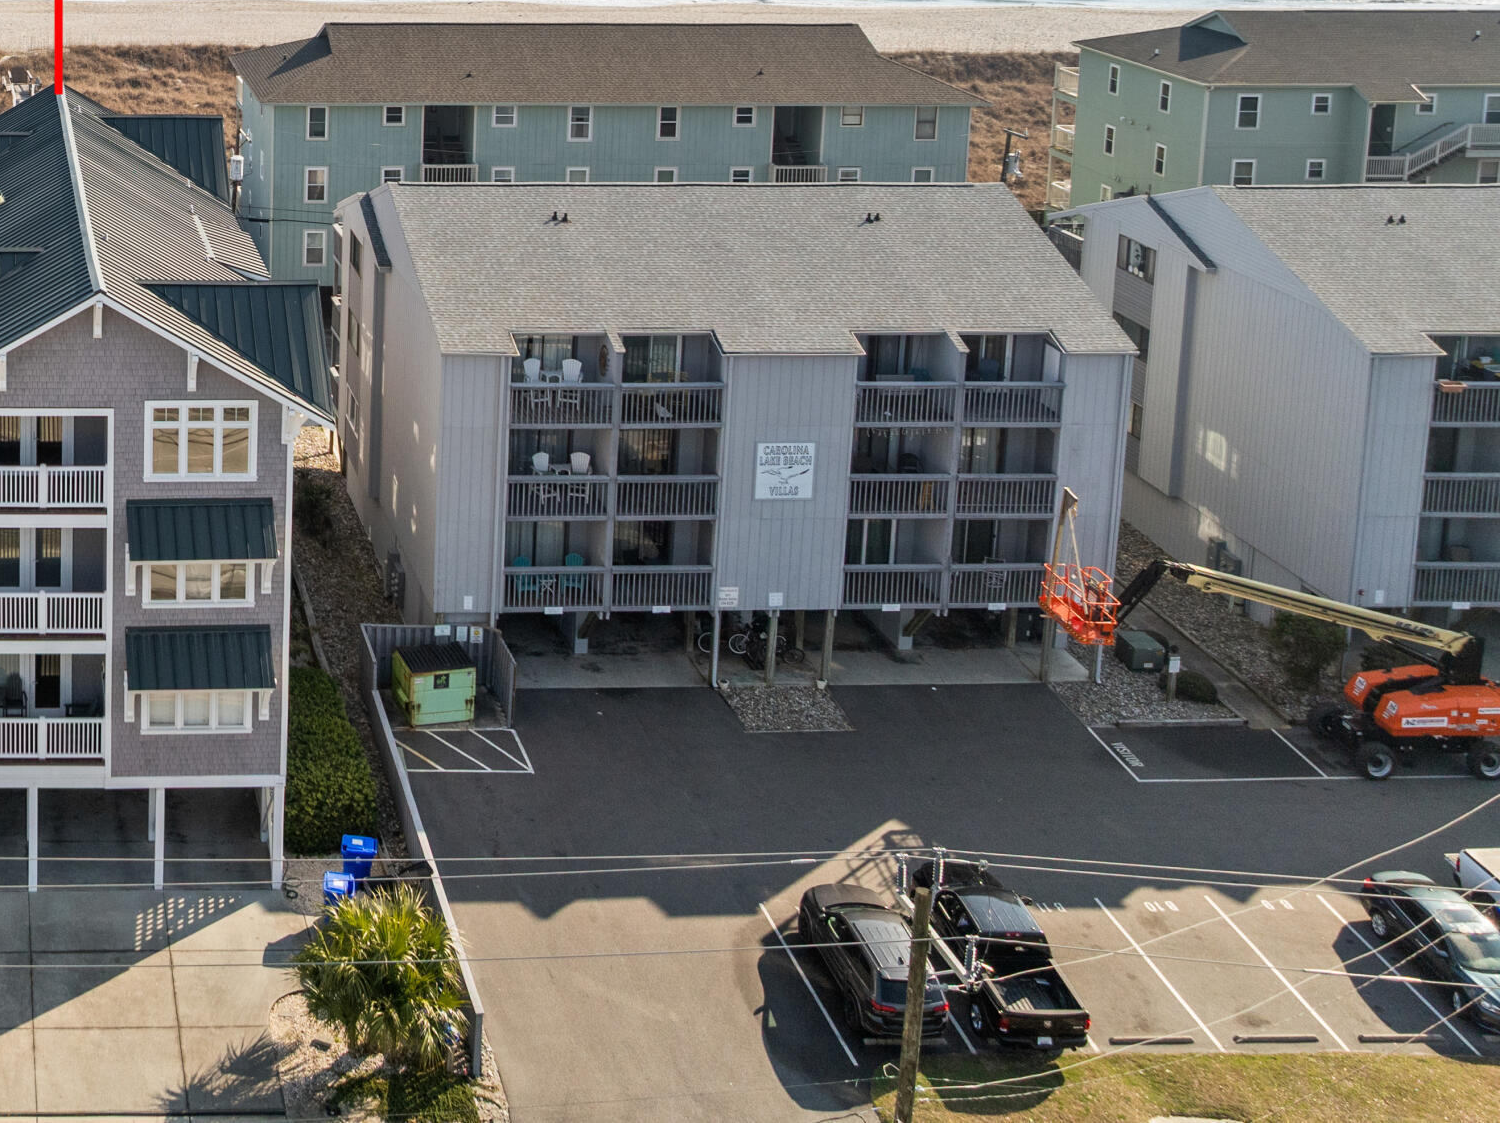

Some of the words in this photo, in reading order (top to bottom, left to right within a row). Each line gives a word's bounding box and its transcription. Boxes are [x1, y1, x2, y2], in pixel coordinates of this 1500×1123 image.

[763, 445, 809, 455] CAROLINA
[759, 456, 781, 466] LAKE
[783, 455, 812, 465] BEACH
[769, 486, 799, 496] VILLAS
